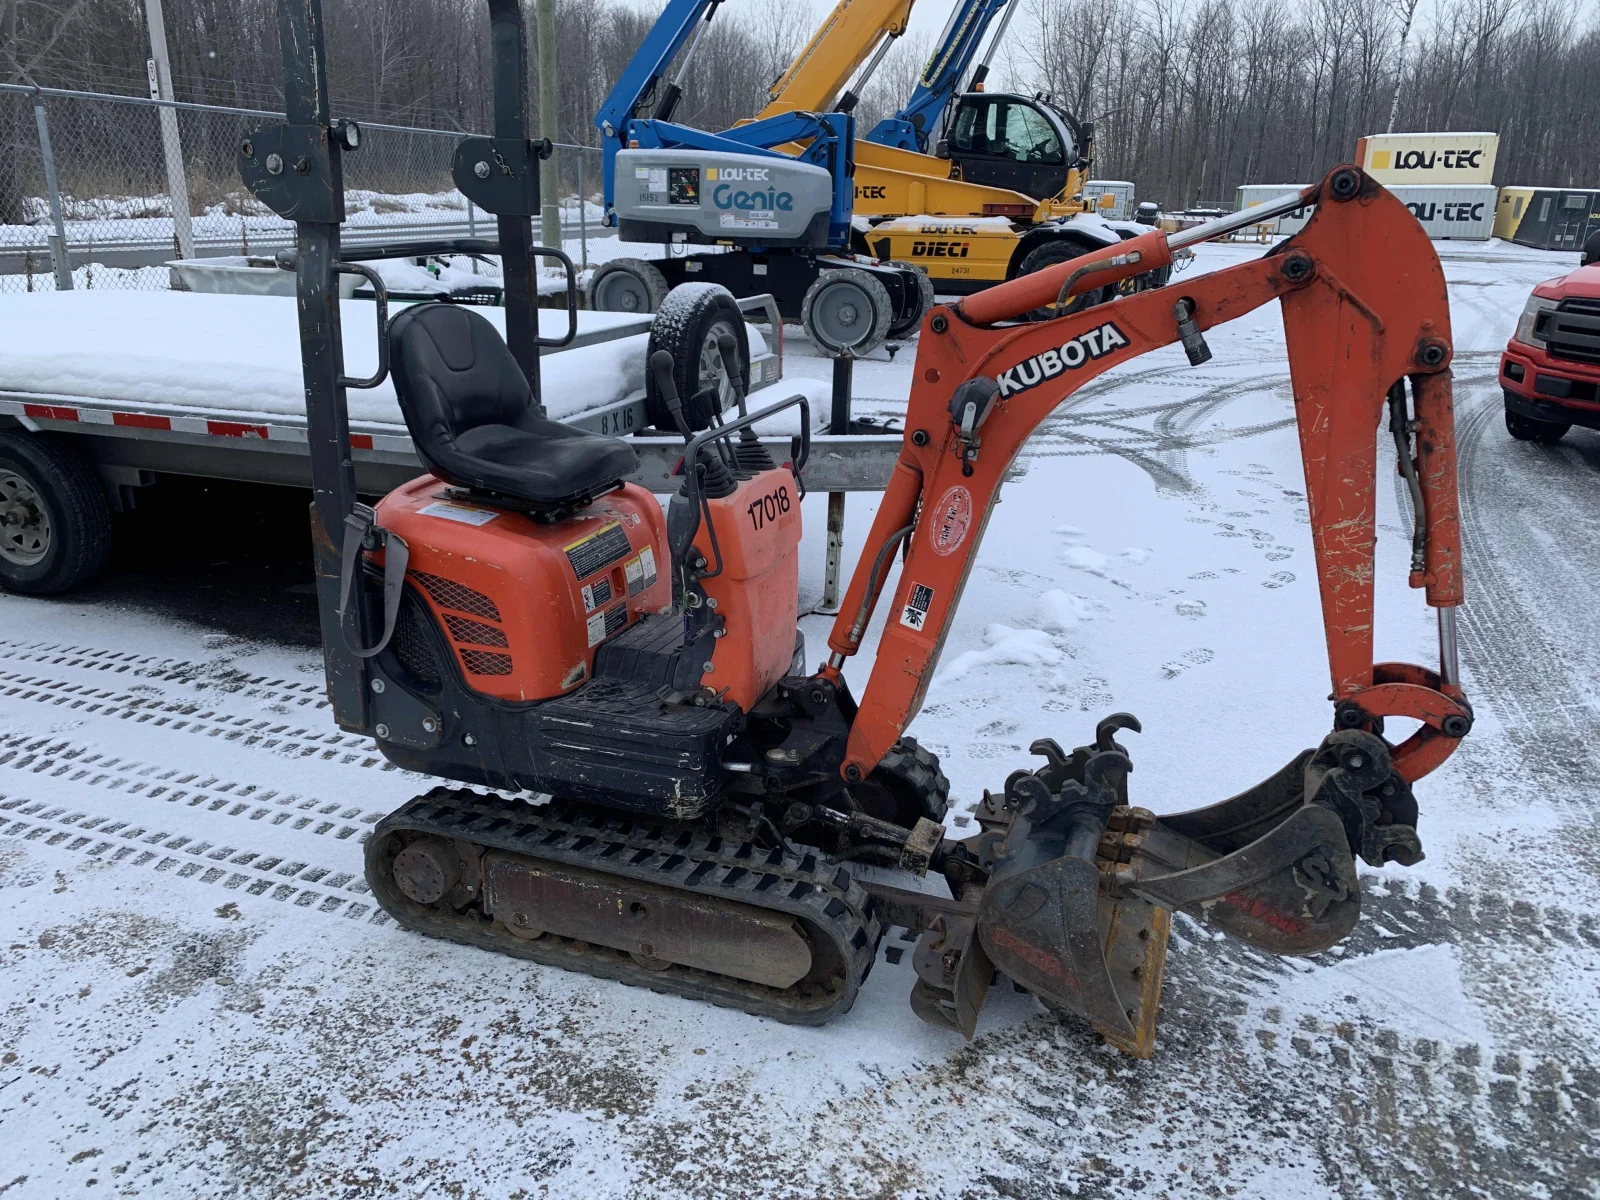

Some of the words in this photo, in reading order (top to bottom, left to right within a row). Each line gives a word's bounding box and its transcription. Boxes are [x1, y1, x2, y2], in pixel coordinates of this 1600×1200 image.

[713, 184, 793, 212] Genie
[912, 241, 970, 257] DIECI
[996, 323, 1128, 399] KUBOTA
[602, 415, 608, 436] 8
[612, 411, 619, 434] X
[623, 407, 633, 430] 16
[747, 486, 791, 531] 17018
